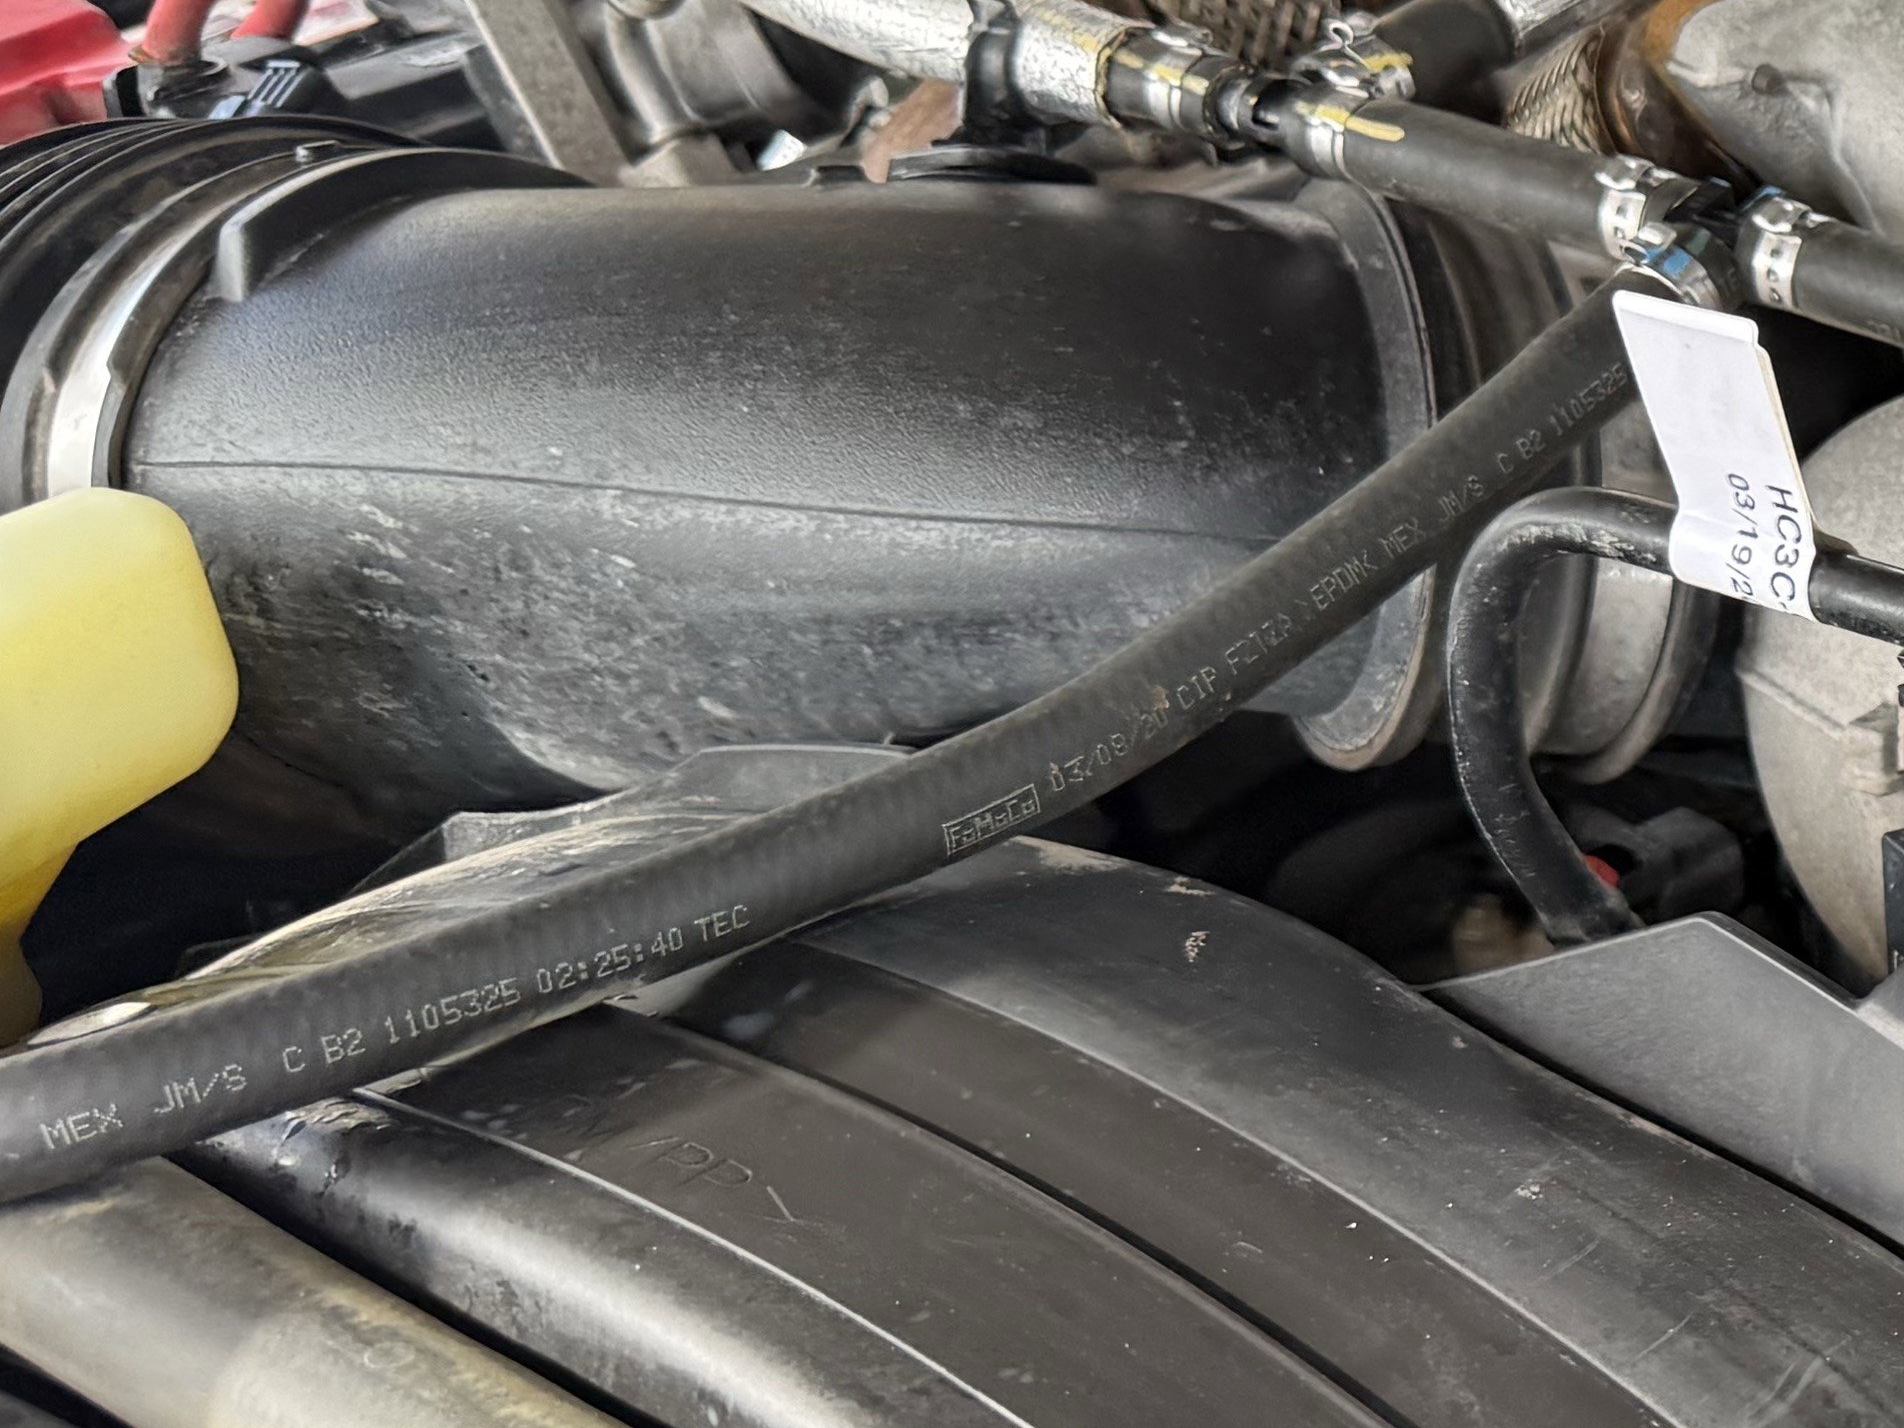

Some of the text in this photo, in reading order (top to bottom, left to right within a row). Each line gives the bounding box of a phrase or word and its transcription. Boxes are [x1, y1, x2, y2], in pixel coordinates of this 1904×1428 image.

[1726, 472, 1757, 603] 03/19/2
[39, 1103, 124, 1149] MEX
[154, 1063, 247, 1113] JM/S
[282, 1046, 305, 1072] C
[319, 1028, 366, 1065] B2
[384, 977, 523, 1044] 1105325
[535, 927, 684, 994] 02:25:40
[694, 904, 750, 942] TEC
[1176, 666, 1216, 710] CIP
[1378, 517, 1426, 558] MEX
[1516, 429, 1546, 460] B2
